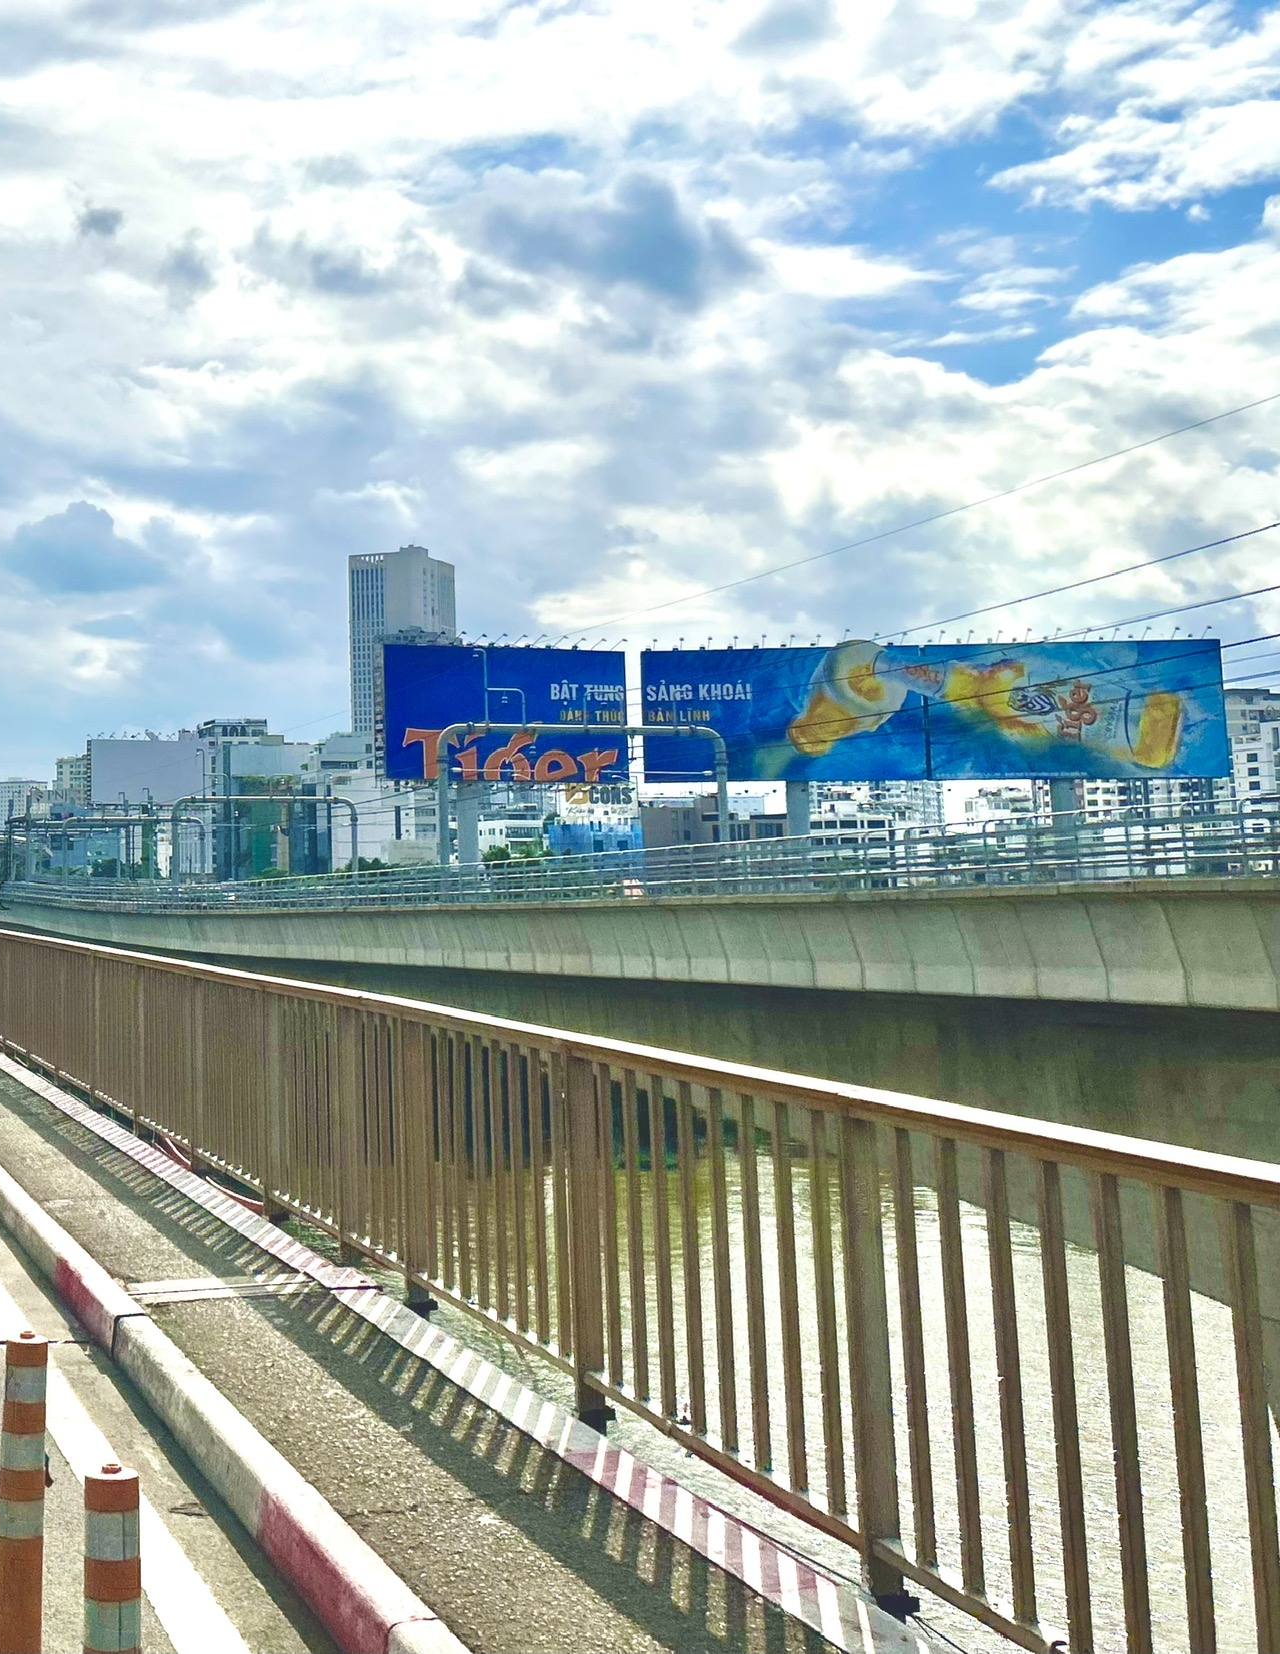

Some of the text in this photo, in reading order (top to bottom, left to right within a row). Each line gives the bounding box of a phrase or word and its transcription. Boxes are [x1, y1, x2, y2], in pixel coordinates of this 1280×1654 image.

[550, 679, 579, 706] BẬT
[646, 679, 753, 702] SẢNG KHOÁI
